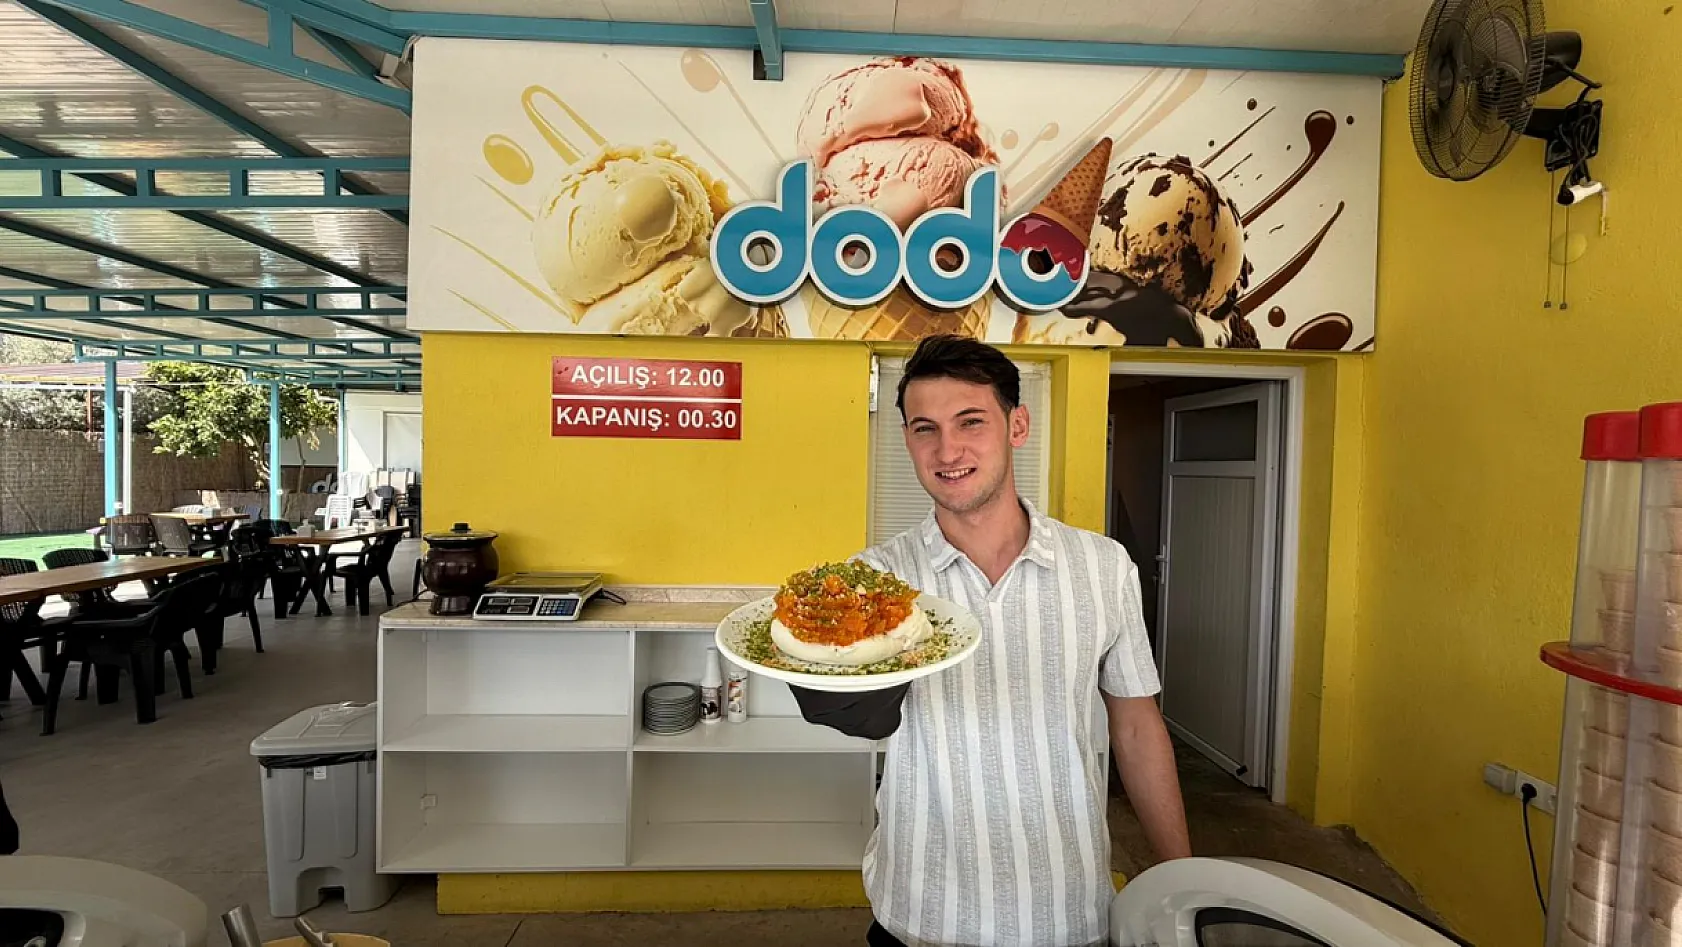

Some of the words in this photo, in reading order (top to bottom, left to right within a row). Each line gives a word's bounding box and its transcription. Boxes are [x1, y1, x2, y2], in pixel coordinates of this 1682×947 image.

[710, 159, 1090, 311] dodo
[571, 364, 658, 388] AÇILIŞ:
[667, 367, 725, 387] 12.00
[556, 406, 669, 431] KAPANIŞ:
[677, 409, 737, 428] 00.30
